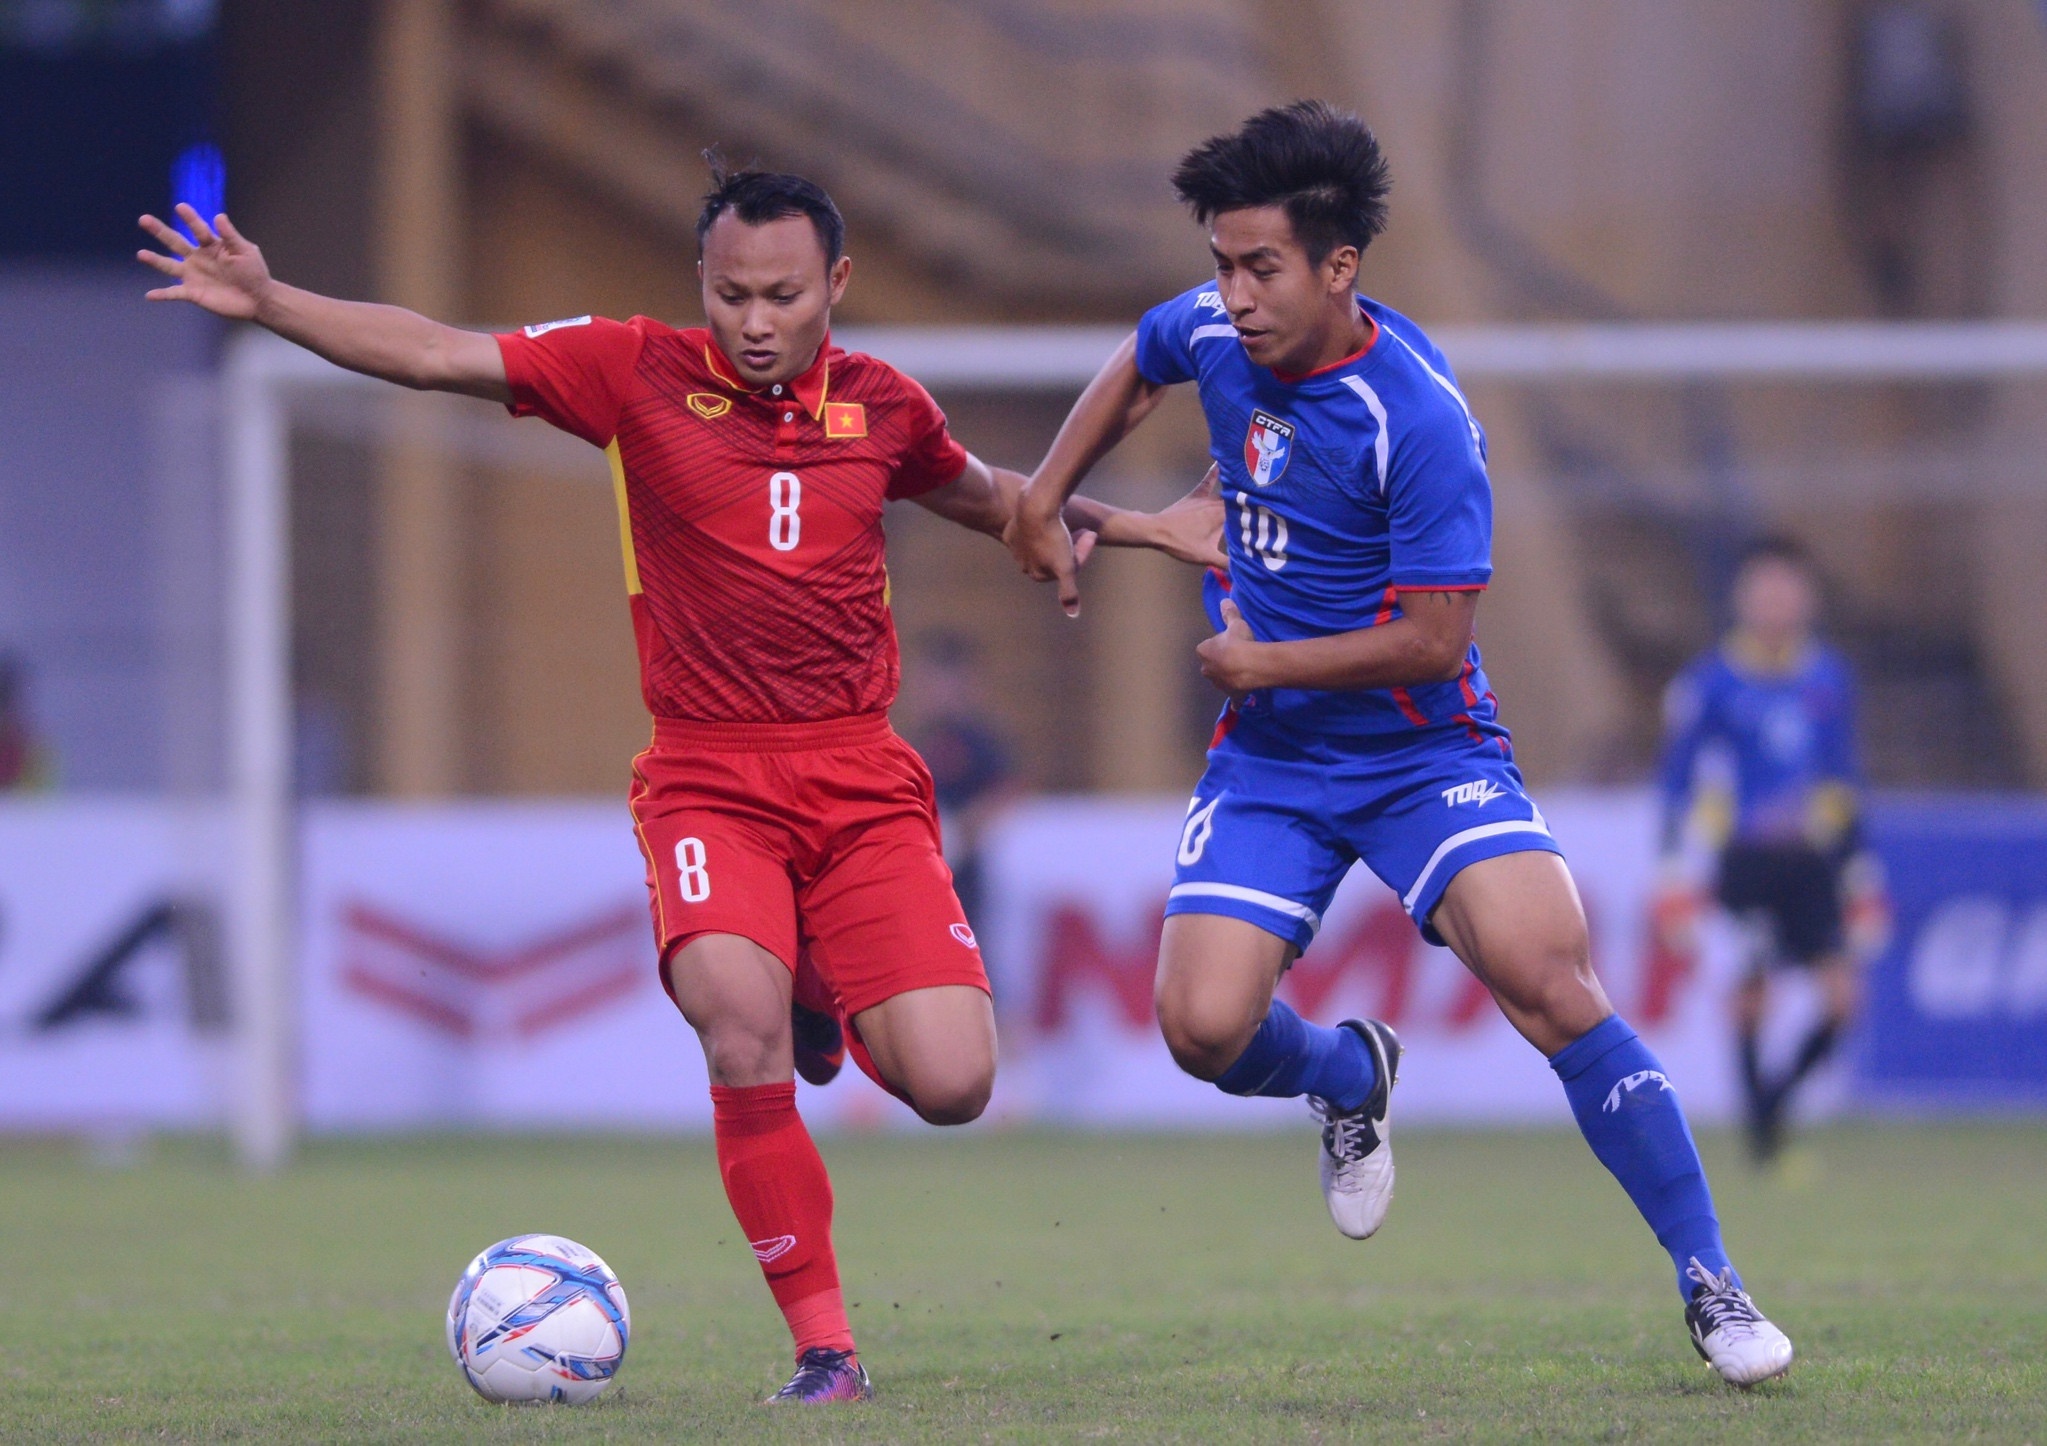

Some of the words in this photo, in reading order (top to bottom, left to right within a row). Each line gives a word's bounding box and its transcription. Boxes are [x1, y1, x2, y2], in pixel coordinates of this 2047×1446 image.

[1255, 415, 1291, 437] CTFA
[769, 471, 801, 551] 8
[1236, 492, 1289, 572] 10
[674, 837, 710, 902] 8
